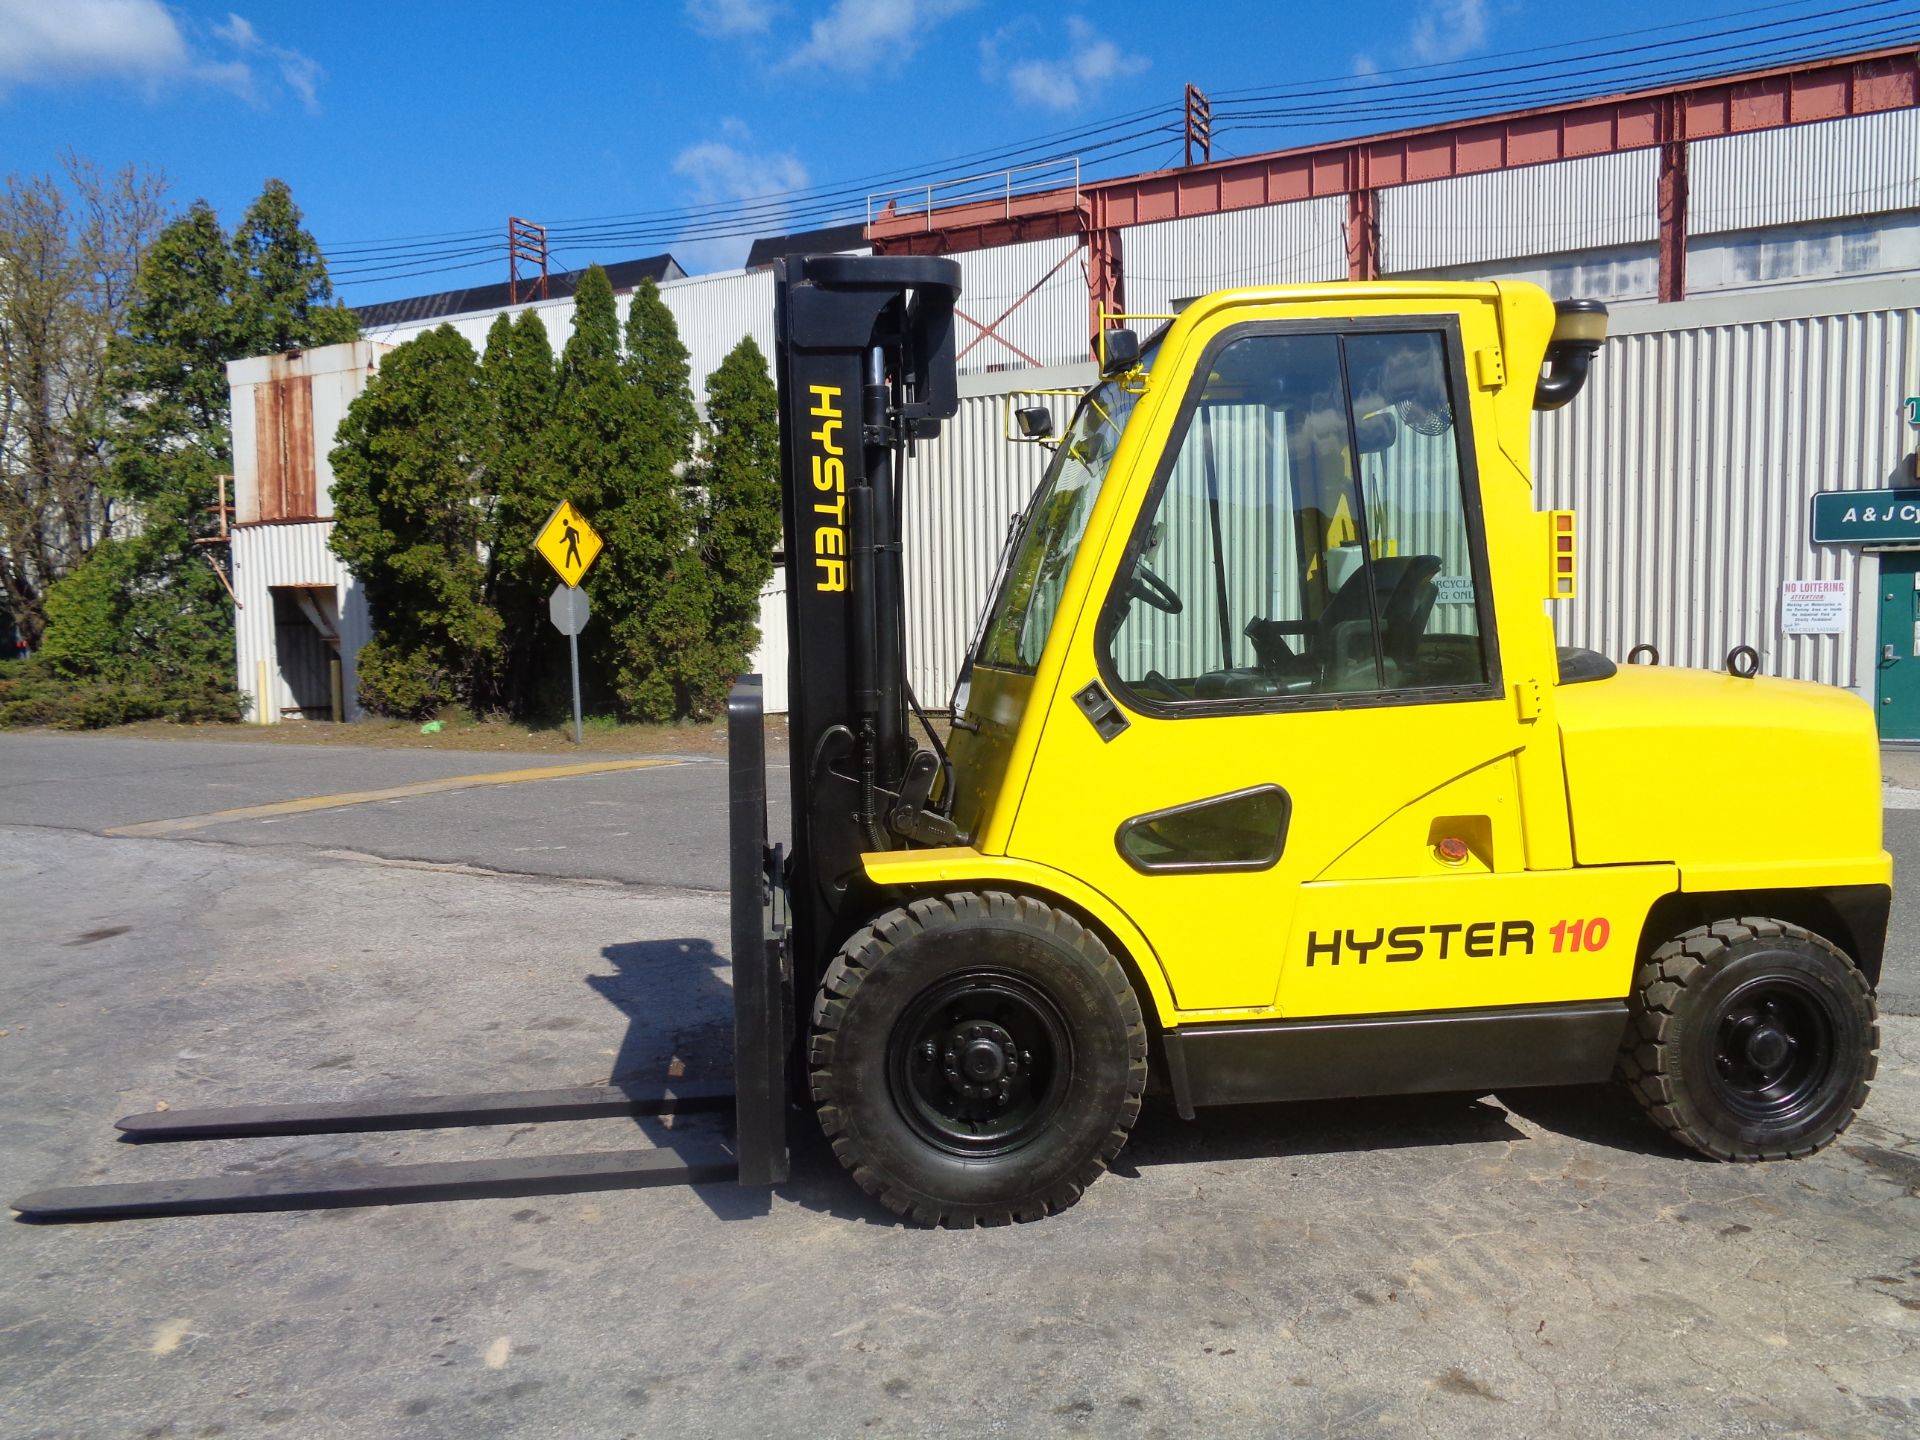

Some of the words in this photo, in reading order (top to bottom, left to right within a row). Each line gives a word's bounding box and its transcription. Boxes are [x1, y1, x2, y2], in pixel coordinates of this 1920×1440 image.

[809, 384, 847, 592] HYSTER
[1841, 507, 1857, 523] A
[1862, 507, 1876, 522] &
[1882, 506, 1895, 521] J
[1433, 579, 1473, 589] RCYCL
[1785, 583, 1797, 593] NO
[1800, 582, 1845, 593] LOITERING
[1306, 920, 1534, 967] HYSTER
[1549, 917, 1610, 954] 110
